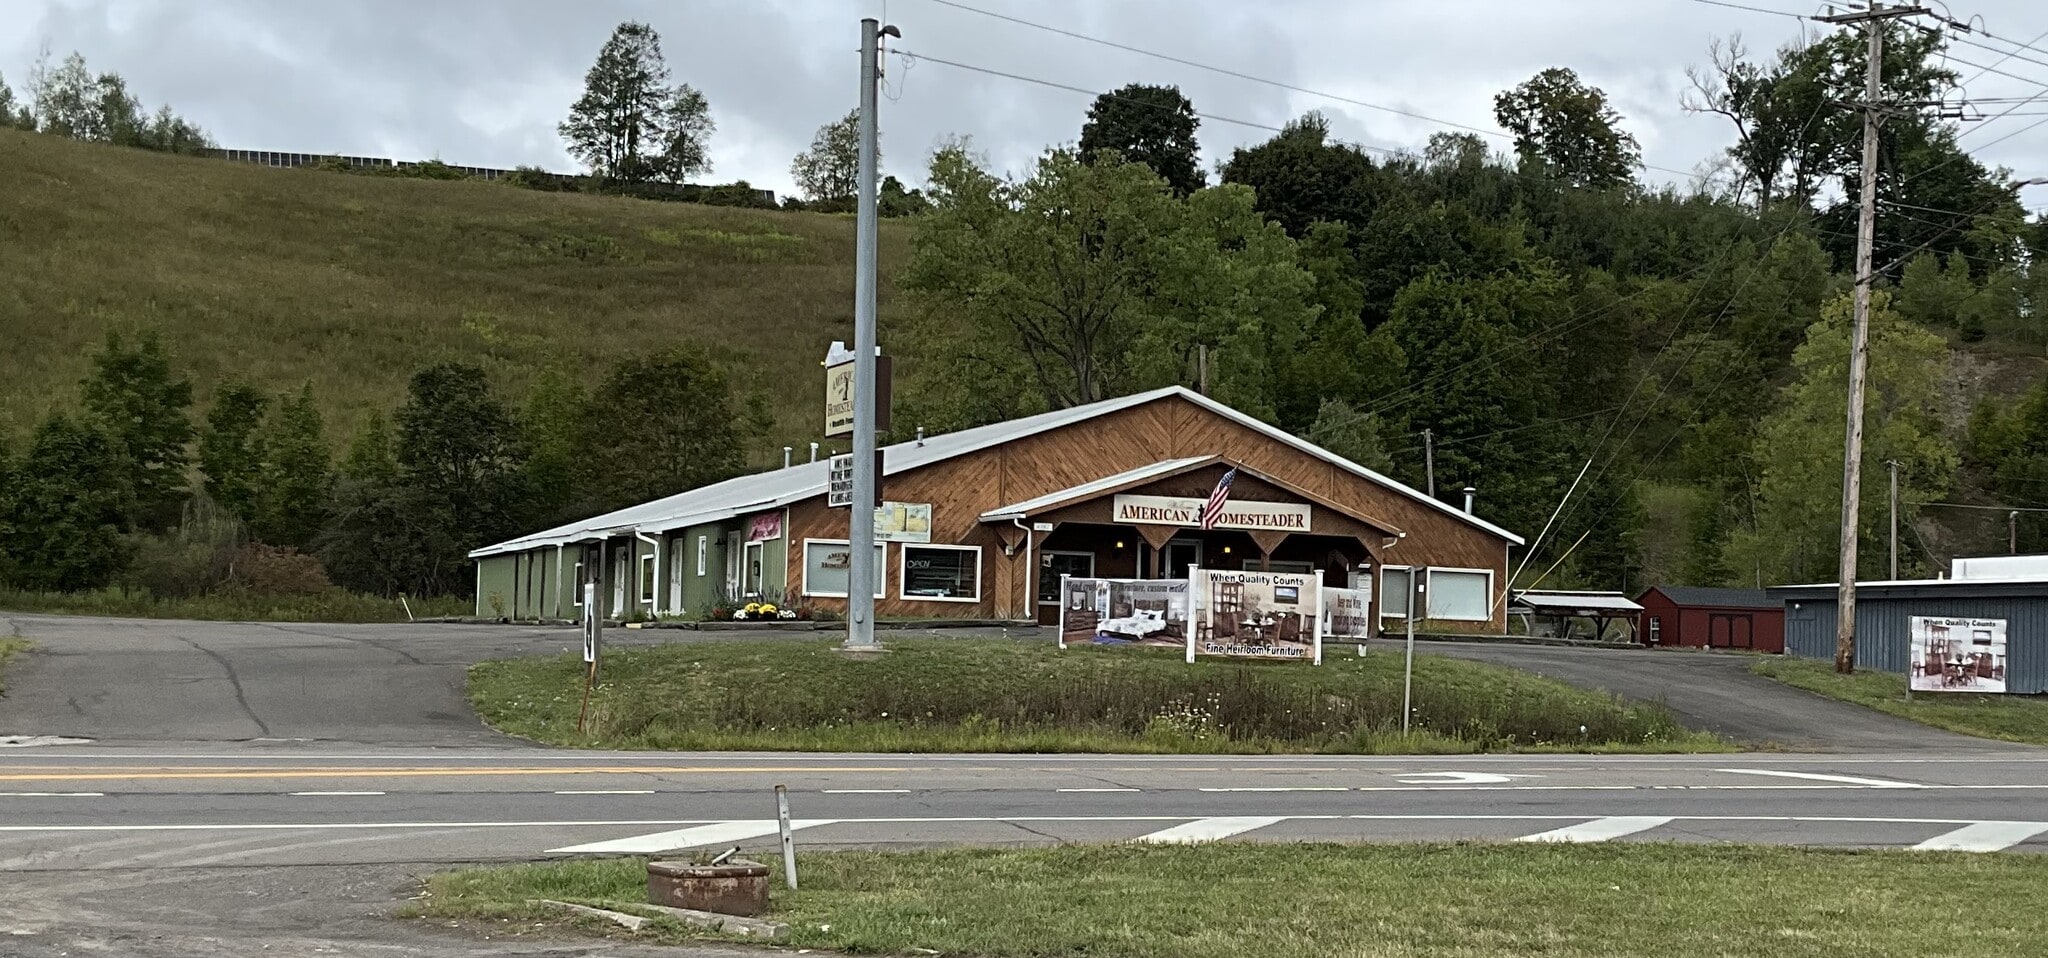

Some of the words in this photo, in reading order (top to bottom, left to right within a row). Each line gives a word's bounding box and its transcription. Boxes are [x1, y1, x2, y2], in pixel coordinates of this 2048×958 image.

[1120, 504, 1190, 522] AMERICAN
[1217, 512, 1305, 528] OMESTEADER
[906, 560, 931, 569] OPEN
[1210, 573, 1236, 583] When
[1238, 574, 1271, 586] Quality
[1273, 575, 1305, 586] Counts
[1945, 619, 1970, 628] Quality
[1206, 643, 1224, 654] Fine
[1227, 643, 1264, 654] Heirloom
[1266, 646, 1305, 656] Furniture
